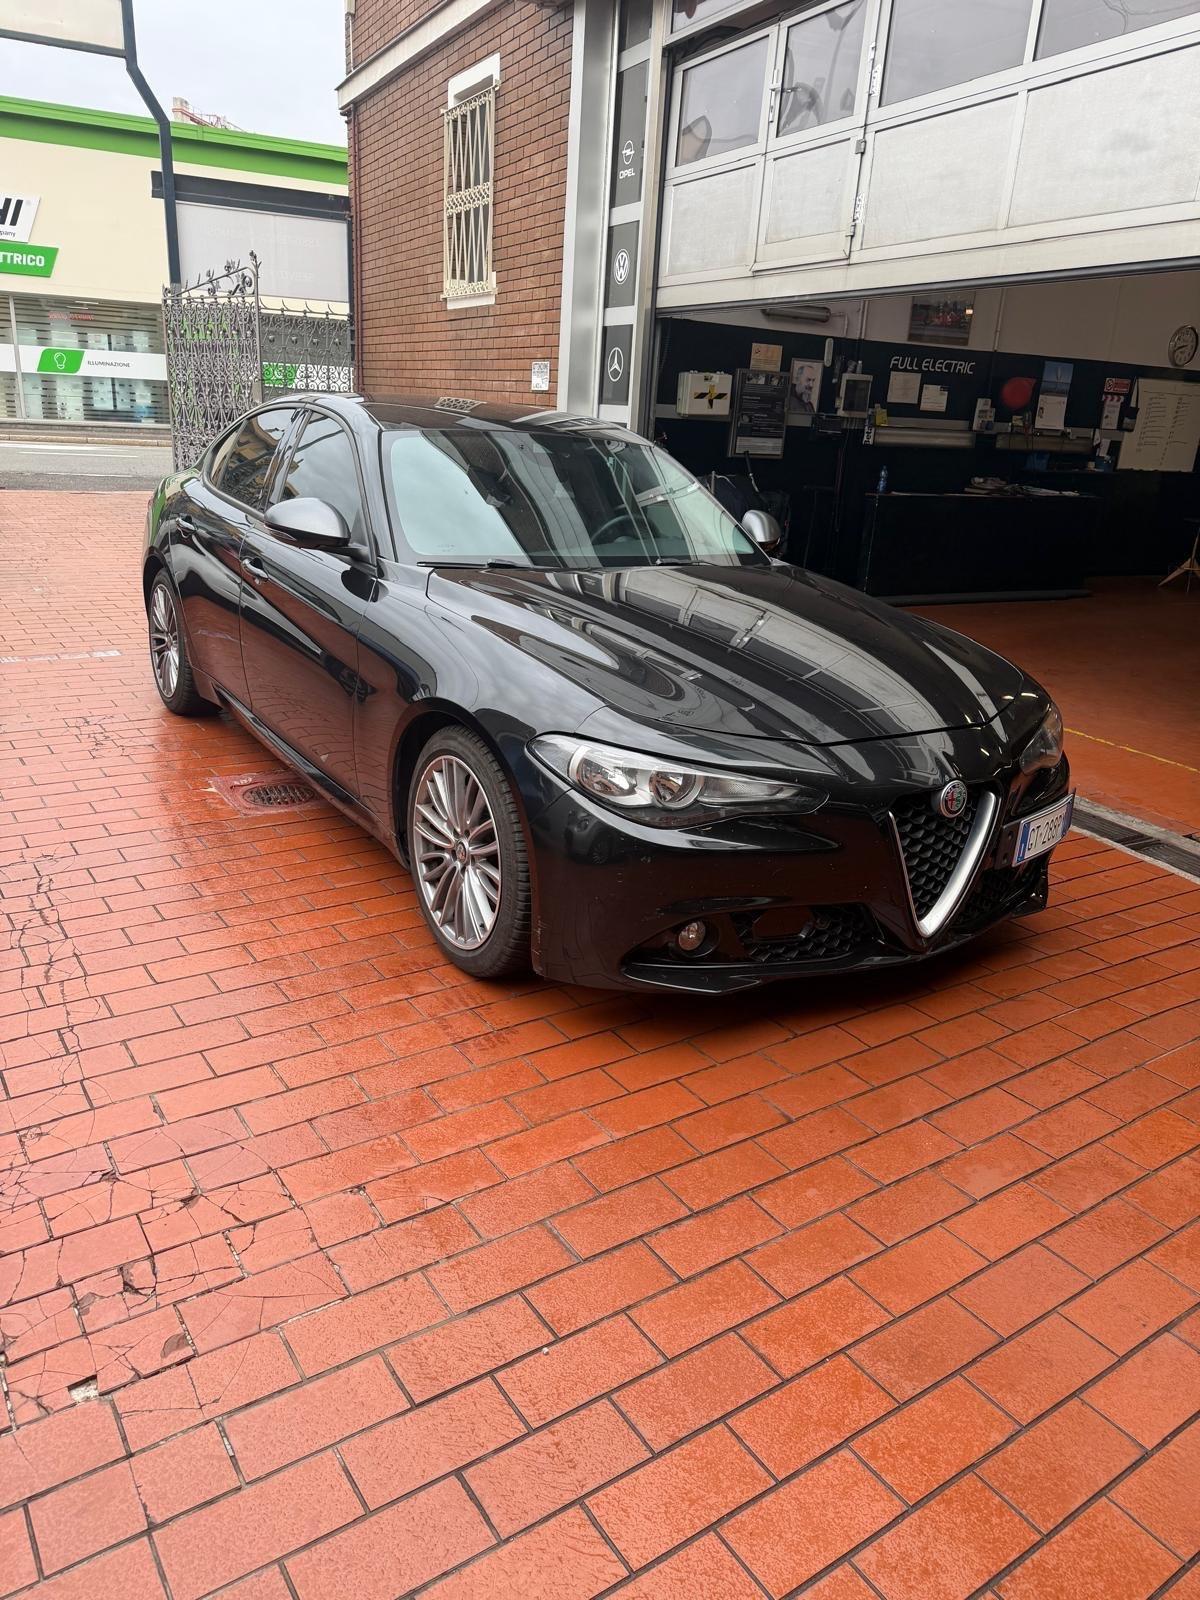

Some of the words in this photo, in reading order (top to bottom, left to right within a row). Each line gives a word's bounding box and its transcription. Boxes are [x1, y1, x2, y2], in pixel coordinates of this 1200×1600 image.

[619, 168, 635, 179] OPEL
[87, 360, 131, 368] ILLUMINAZIONE
[889, 356, 919, 370] FULL
[921, 358, 976, 375] ELECTRIC
